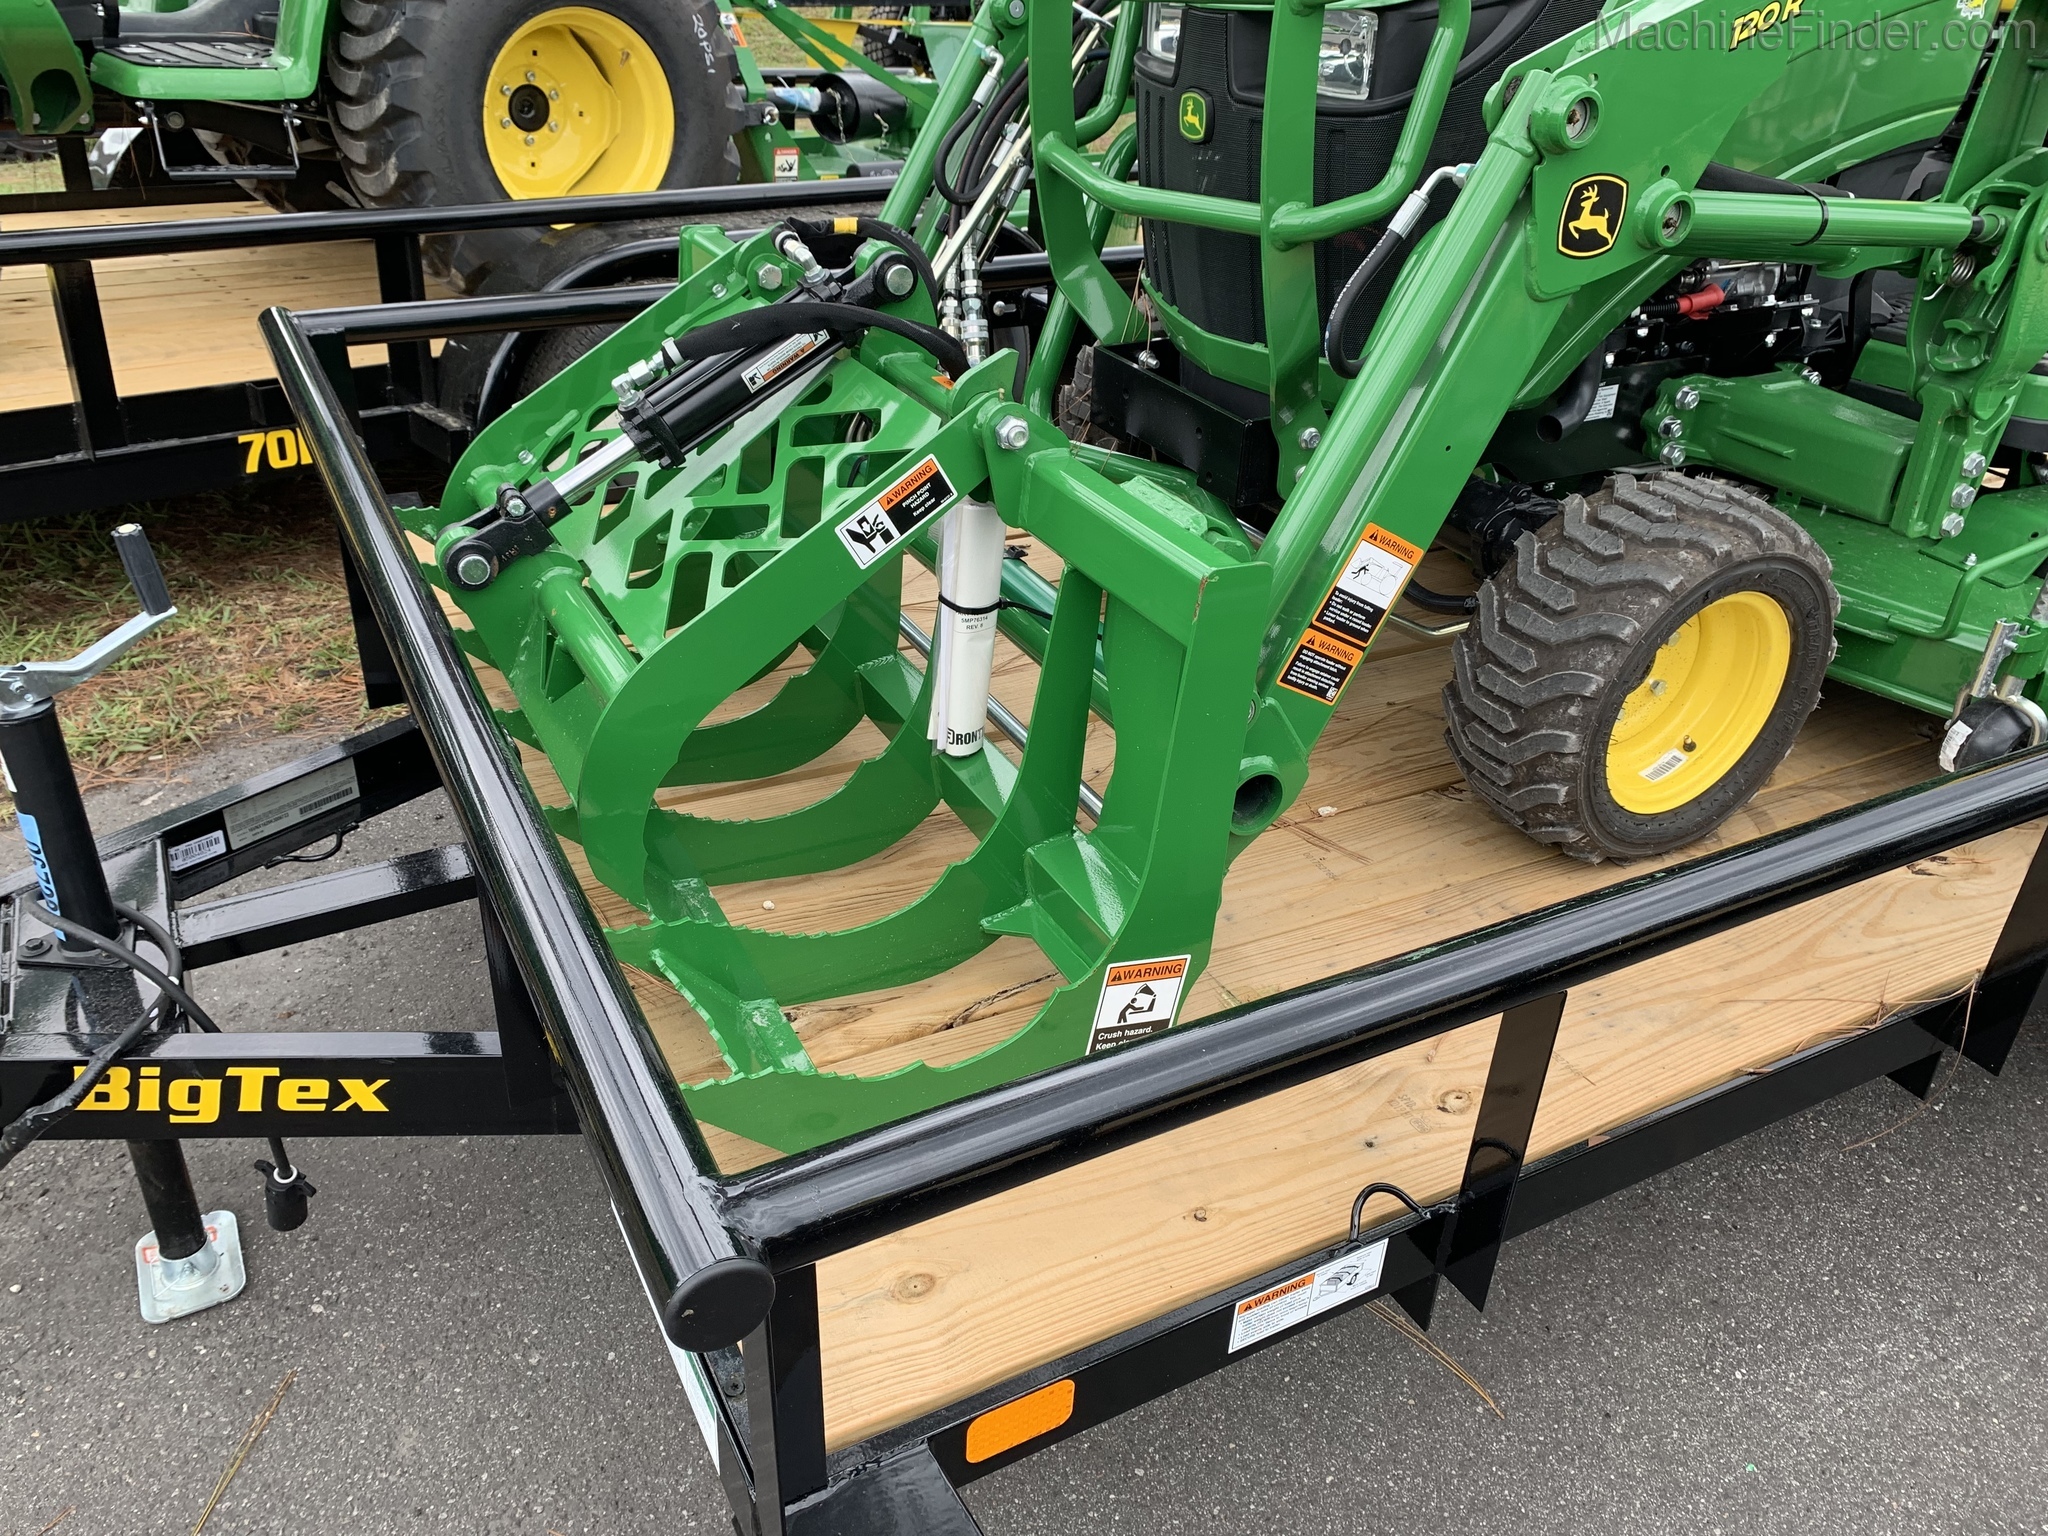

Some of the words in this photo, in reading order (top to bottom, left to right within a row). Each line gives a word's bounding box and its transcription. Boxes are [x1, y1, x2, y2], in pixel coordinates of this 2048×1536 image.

[772, 352, 800, 374] WARNING
[892, 465, 933, 499] WARNING
[902, 493, 918, 508] PINCH
[917, 482, 932, 497] POINT
[910, 491, 930, 509] HAZARD
[913, 505, 926, 517] Keep
[925, 497, 936, 508] clear
[1378, 534, 1415, 560] WARNING
[1318, 639, 1354, 662] WARNING
[1123, 963, 1183, 980] WARNING
[1098, 1031, 1122, 1041] Crush
[1124, 1026, 1153, 1037] hazard.
[1253, 1279, 1306, 1308] WARNING
